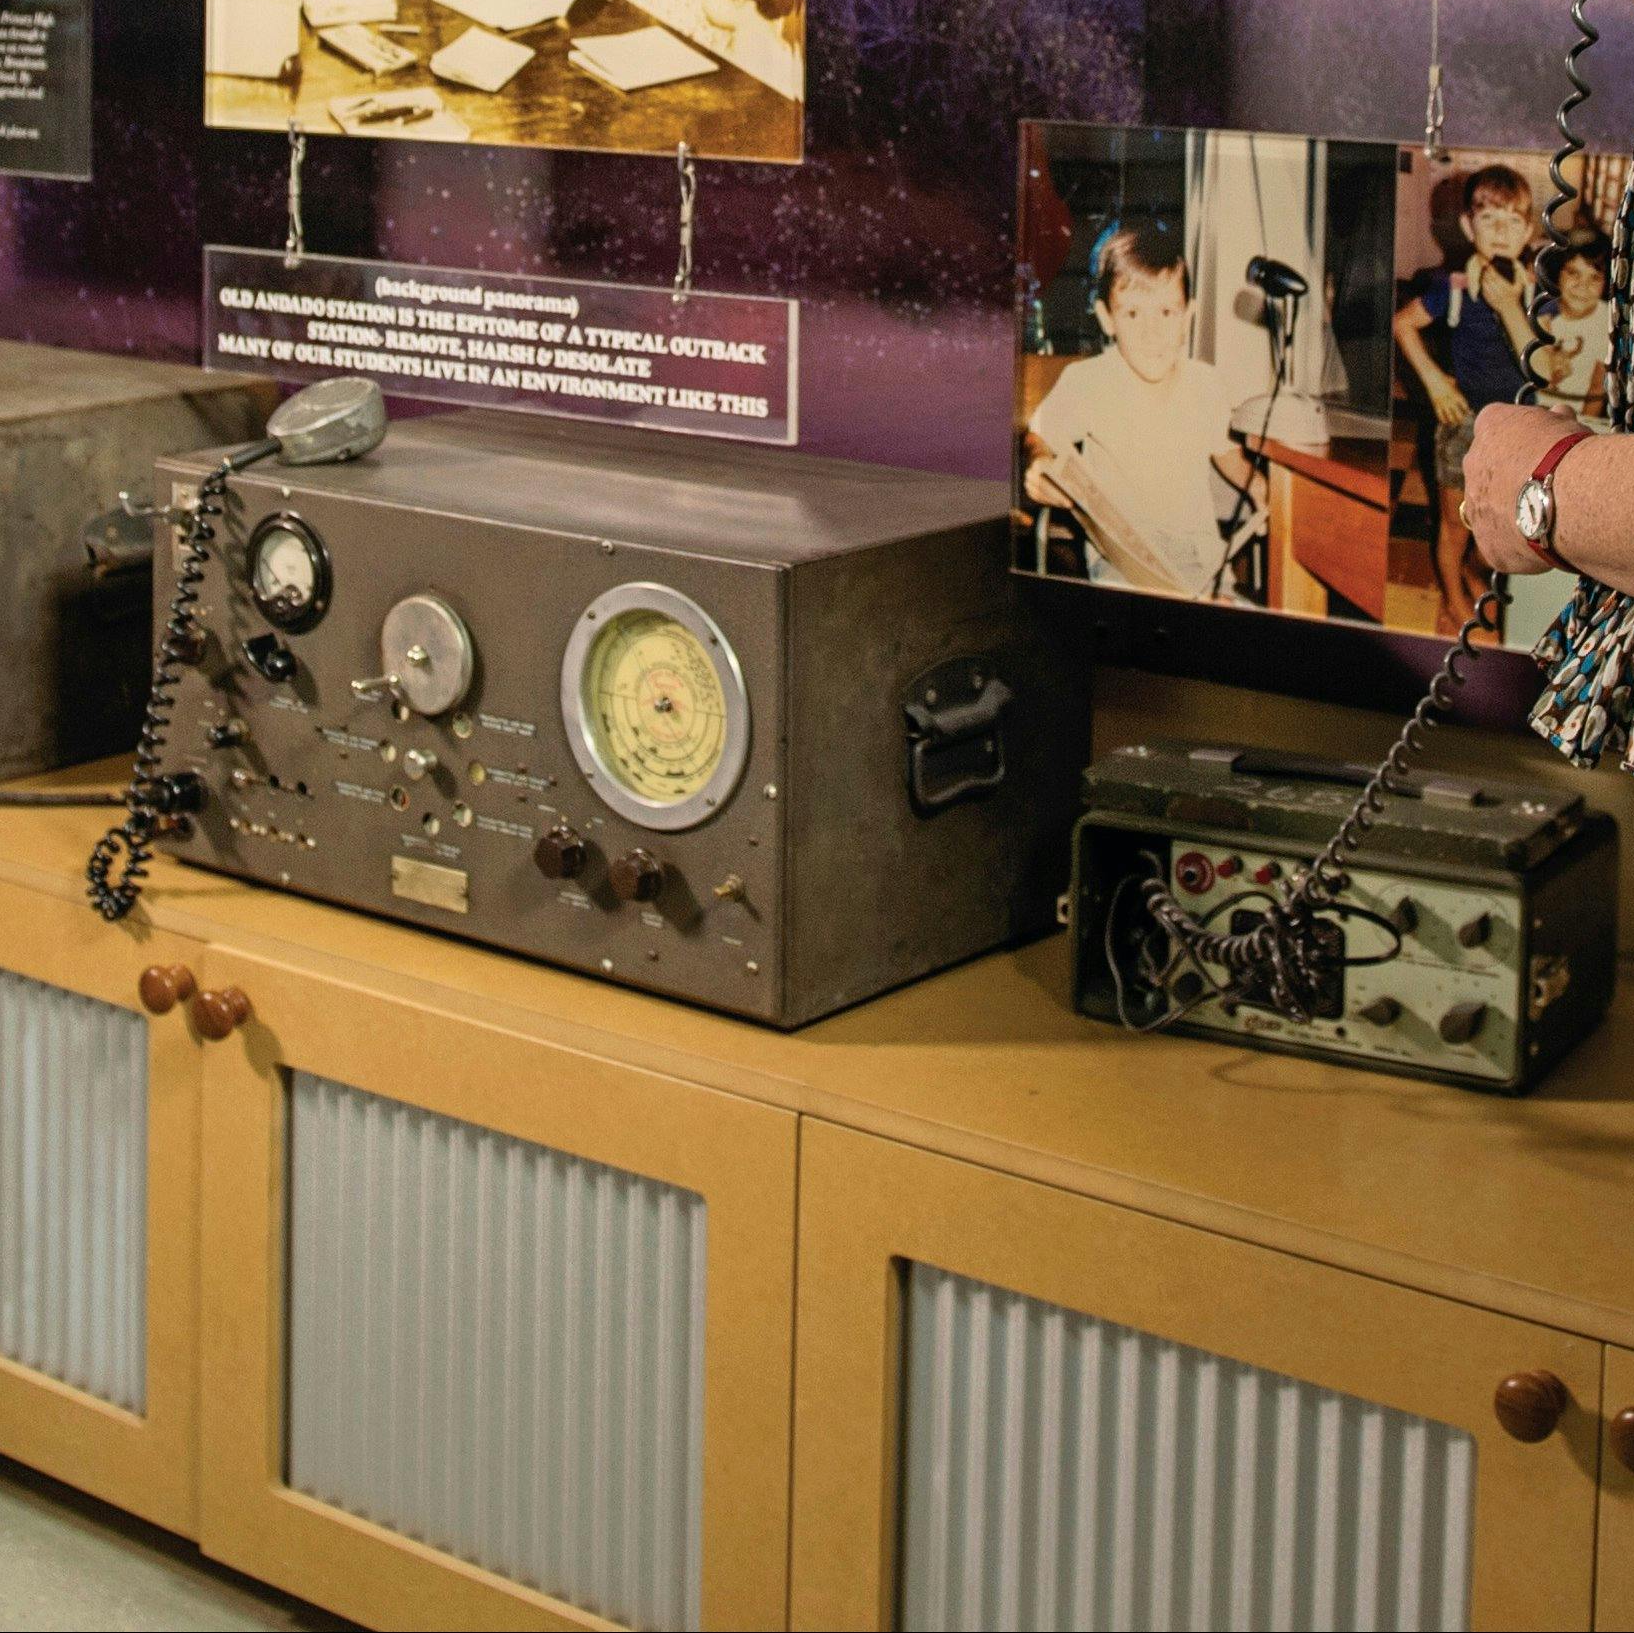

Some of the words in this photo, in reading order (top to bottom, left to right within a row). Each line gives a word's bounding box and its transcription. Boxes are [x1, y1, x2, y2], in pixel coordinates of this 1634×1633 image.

[220, 287, 254, 309] OLD
[255, 290, 326, 317] ANDADO
[326, 298, 396, 325] STATION
[398, 306, 415, 327] IS
[416, 308, 455, 330] THE
[456, 312, 540, 341] EPITOME
[540, 323, 567, 343] OF
[567, 325, 584, 345] A
[584, 326, 668, 355] TYPICAL
[670, 336, 766, 365] OUTBACK
[375, 276, 483, 305] (background
[483, 290, 580, 319] panorama)
[217, 333, 272, 357] MANY
[271, 340, 294, 360] OF
[295, 342, 332, 365] OUR
[333, 347, 422, 376] STUDENTS
[422, 358, 467, 382] LIVE
[468, 364, 491, 385] IN
[491, 367, 520, 388] AN
[520, 369, 666, 406] ENVIRONMENT
[667, 388, 716, 412] LIKE
[717, 394, 769, 418] THIS
[385, 330, 467, 359] REMOTE,
[467, 339, 535, 366] HARSH
[536, 348, 554, 366] &
[555, 349, 652, 378] DESOLATE
